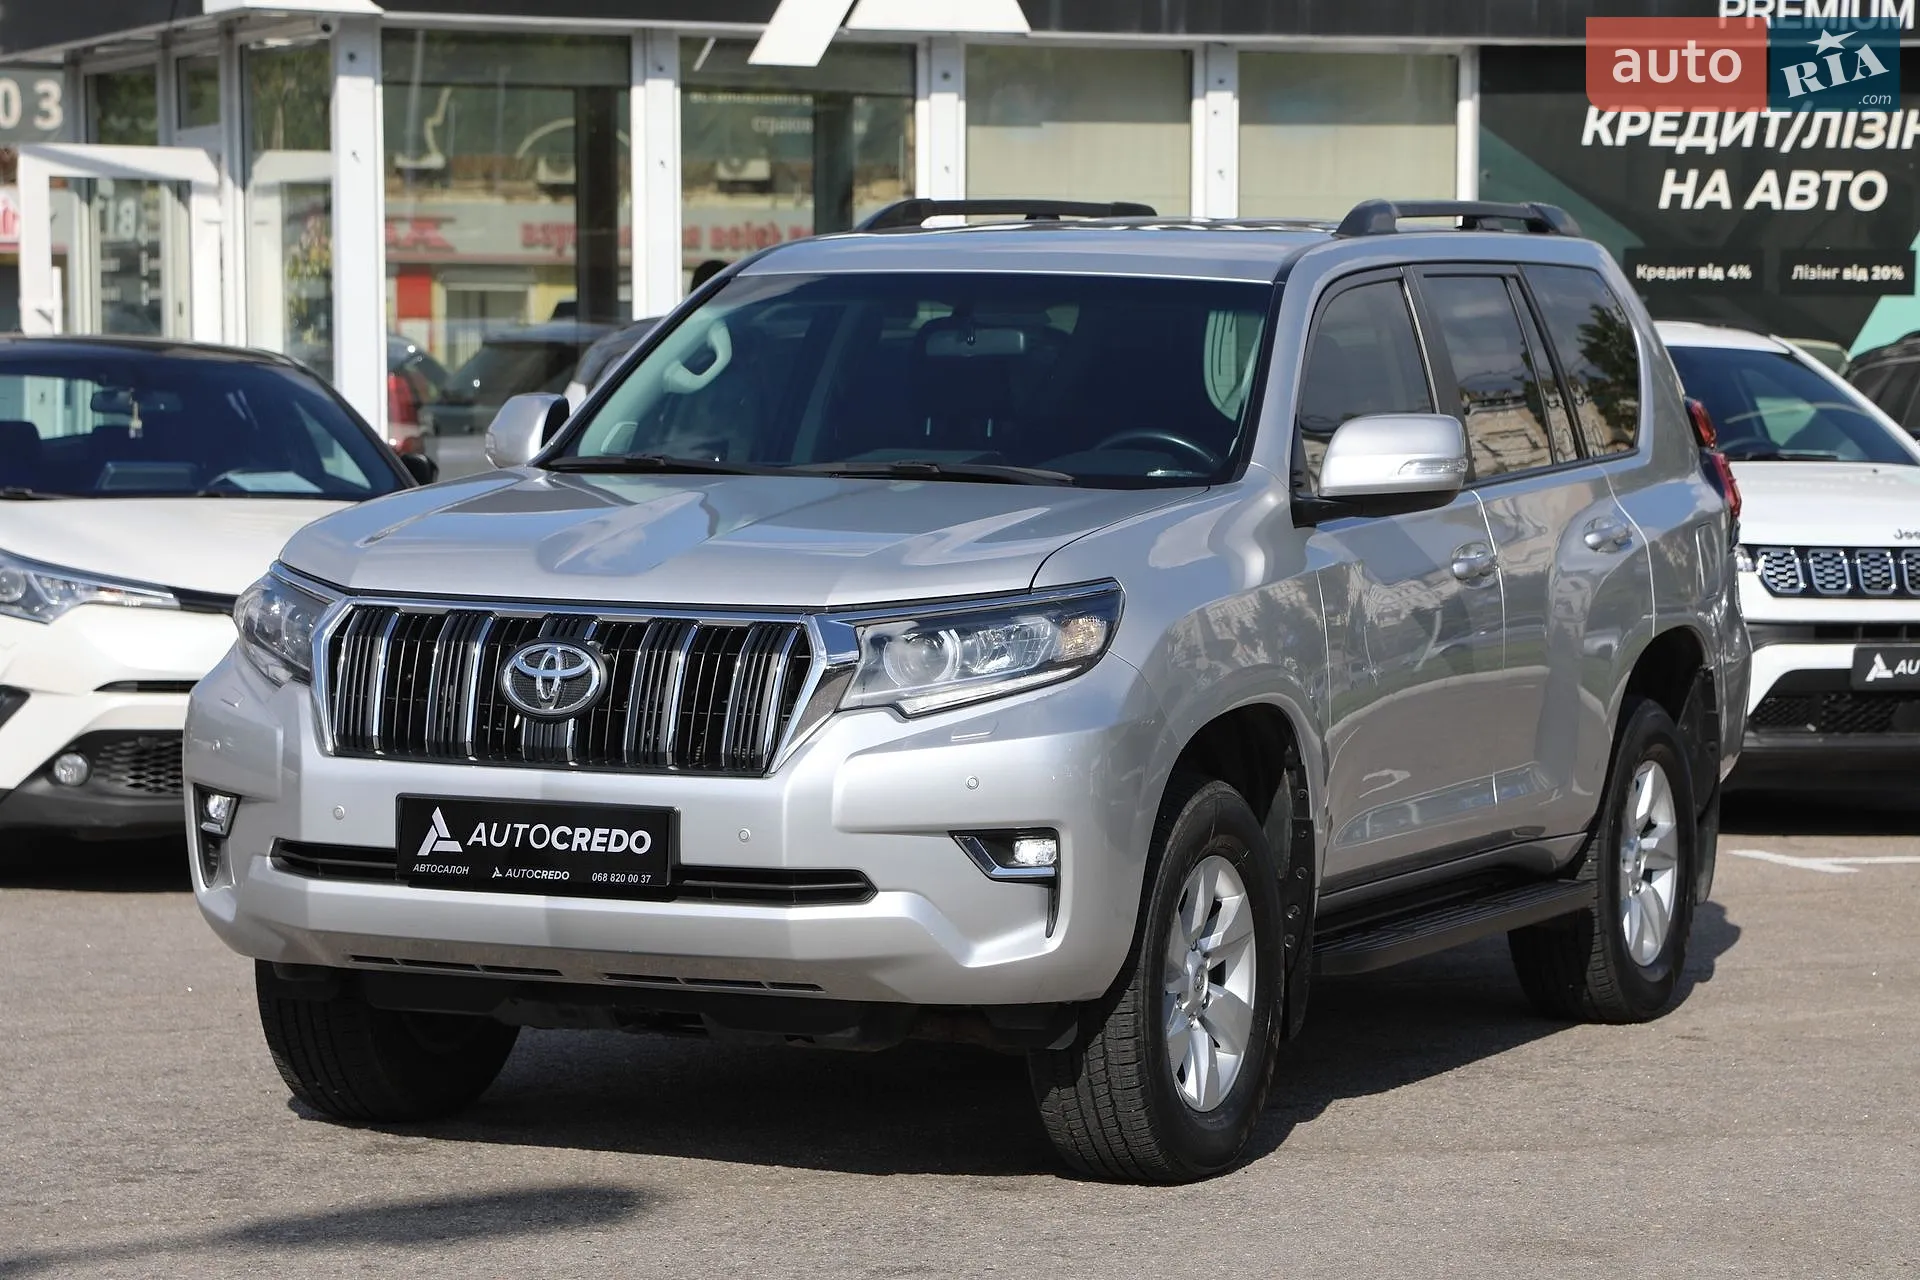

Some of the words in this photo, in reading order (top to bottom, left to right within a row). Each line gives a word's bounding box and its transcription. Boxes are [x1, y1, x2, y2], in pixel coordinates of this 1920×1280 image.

[1718, 0, 1915, 29] PREMIUM
[1658, 168, 1732, 210] НА
[1743, 169, 1888, 212] АВТО
[1636, 263, 1695, 281] Кредит
[1698, 263, 1724, 282] від
[1727, 264, 1752, 280] 4%
[1791, 264, 1840, 280] Лізінг
[1842, 264, 1869, 282] від
[1871, 265, 1905, 281] 20%
[466, 822, 651, 855] AUTOCREDO
[413, 863, 469, 875] АВТОСАЛОН
[505, 868, 570, 881] AUTOCREDO
[592, 872, 608, 882] 068
[610, 873, 626, 883] 820
[627, 874, 639, 884] 00
[640, 874, 652, 884] 37
